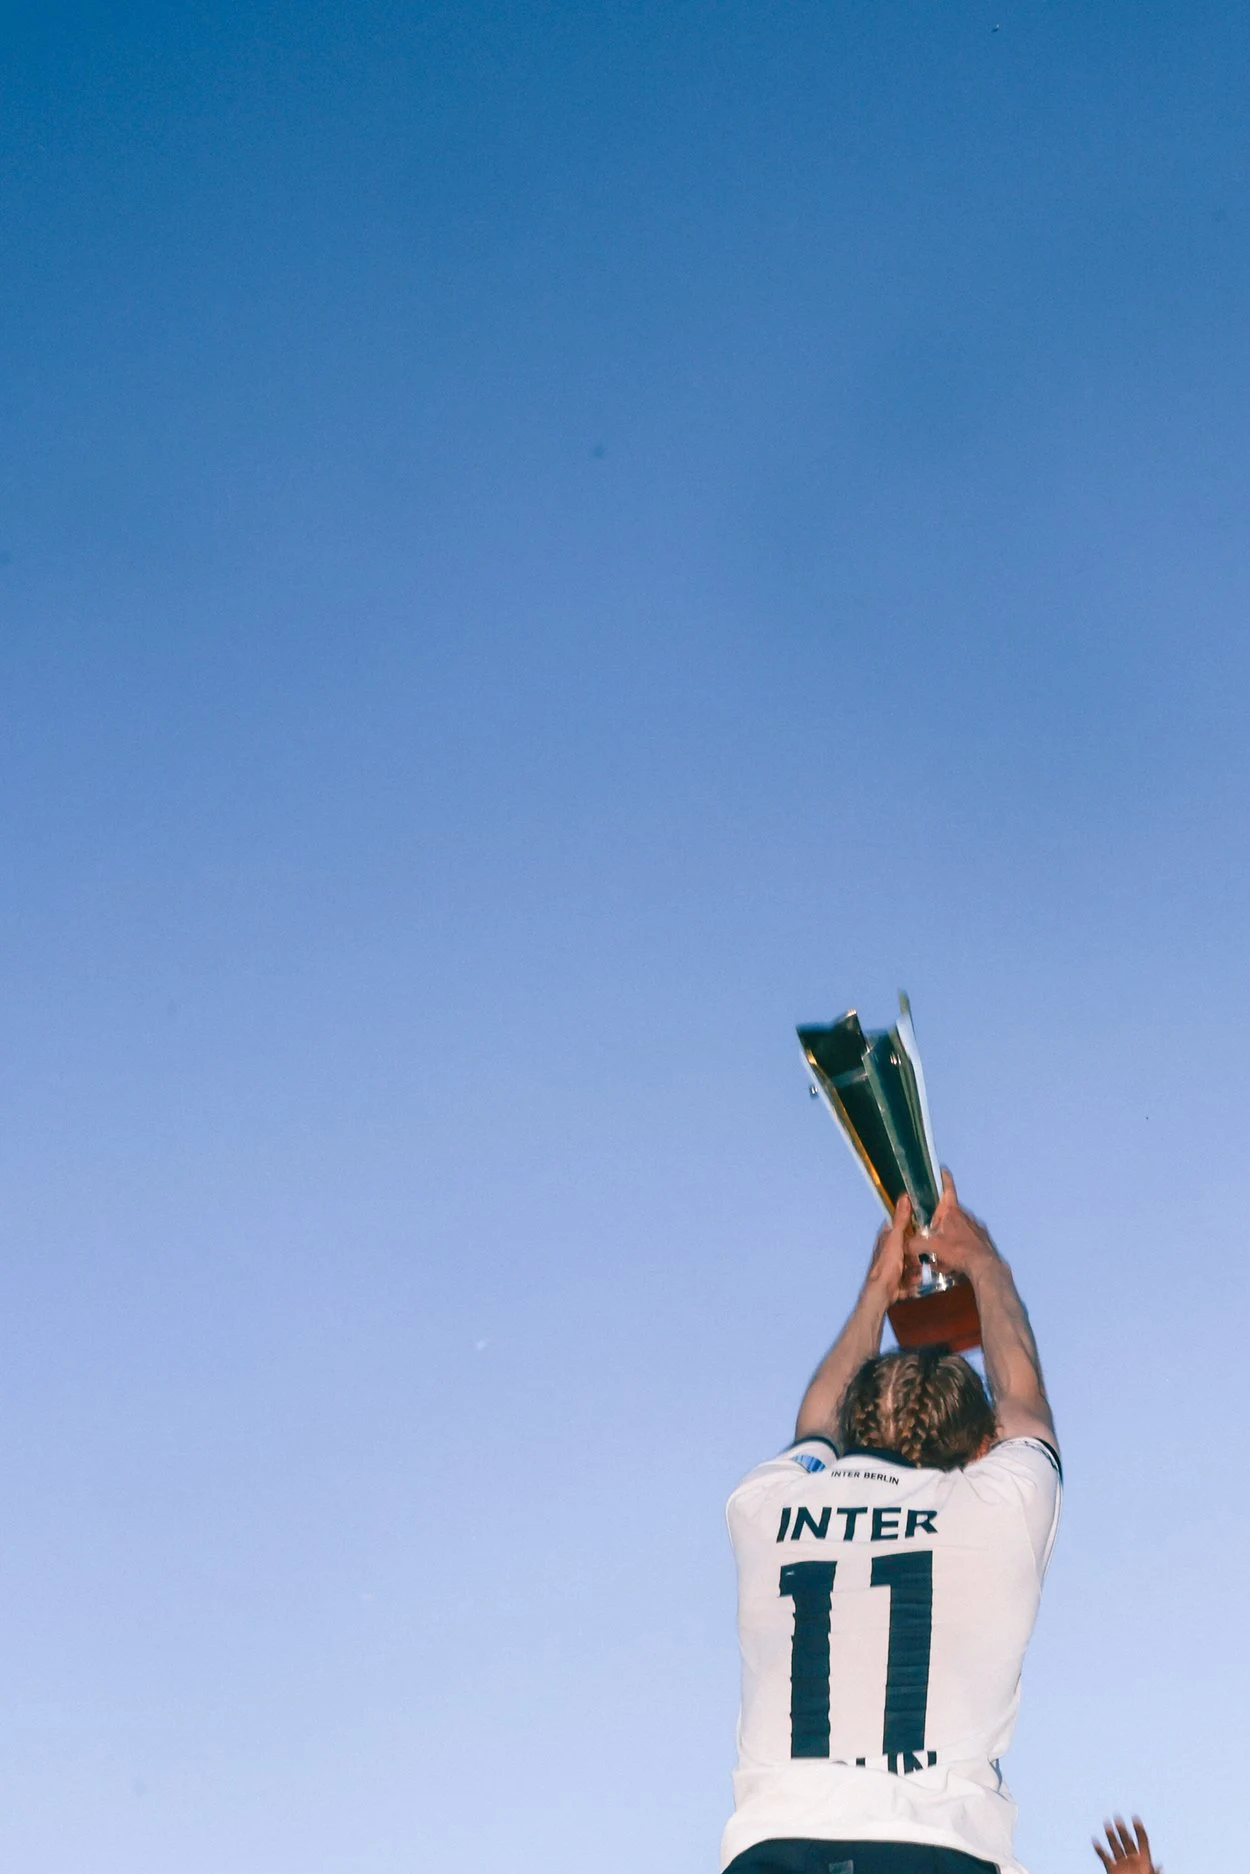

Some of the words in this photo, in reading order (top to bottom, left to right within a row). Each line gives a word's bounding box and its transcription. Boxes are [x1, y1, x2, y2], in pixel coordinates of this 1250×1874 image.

[863, 1472, 900, 1485] BERLIN
[776, 1507, 938, 1543] INTER
[779, 1550, 933, 1760] 11
